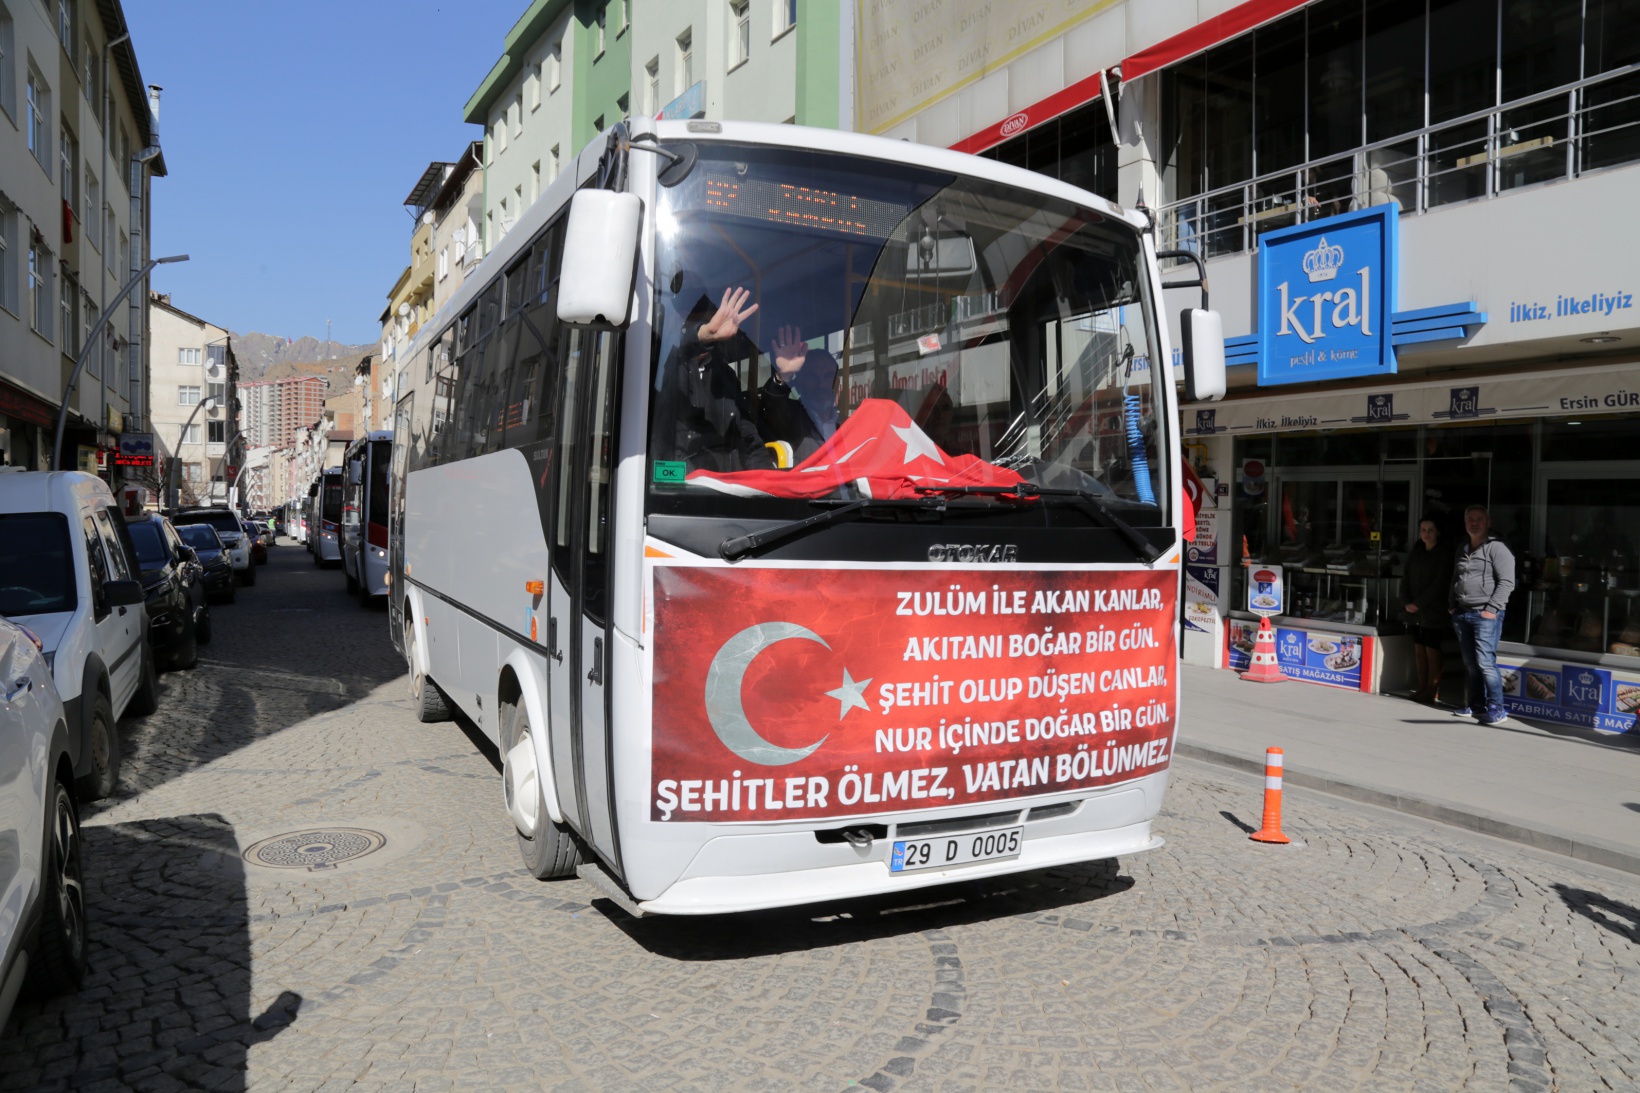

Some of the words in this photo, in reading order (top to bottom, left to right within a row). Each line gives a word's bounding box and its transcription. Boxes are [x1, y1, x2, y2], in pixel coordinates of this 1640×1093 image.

[1276, 266, 1373, 344] kral
[1510, 302, 1552, 323] İlkiz,
[1556, 291, 1633, 317] İlkeliyiz
[1317, 351, 1327, 361] &
[1369, 403, 1391, 418] kral
[1452, 397, 1477, 413] kral
[1560, 396, 1598, 409] Ersin
[928, 543, 1018, 563] OTOKAR
[896, 585, 987, 616] ZULÜM
[992, 584, 1027, 614] İLE
[1031, 589, 1091, 615] AKAN
[1094, 587, 1165, 613] KANLAR,
[903, 634, 1003, 662] AKITANI
[1008, 626, 1082, 658] BOĞAR
[1086, 624, 1116, 653] BİR
[1119, 623, 1160, 650] GÜN.
[1279, 640, 1302, 659] kral
[1302, 669, 1345, 682] MAĞAZASI
[878, 675, 954, 715] ŞEHİT
[959, 676, 1023, 703] OLUP
[1027, 667, 1096, 704] DÜŞEN
[1099, 663, 1168, 693] CANLAR,
[1568, 680, 1603, 705] kral
[1511, 702, 1560, 718] FABRİKA
[1565, 712, 1600, 728] SATIŞ
[874, 727, 932, 754] NUR
[938, 718, 1021, 757] İÇİNDE
[1025, 708, 1097, 741] DOĞAR
[1101, 706, 1133, 732] BİR
[1136, 701, 1170, 728] GÜN.
[656, 770, 830, 821] ŞEHİTLER
[837, 764, 955, 804] ÖLMEZ,
[963, 758, 1051, 795] VATAN
[1055, 737, 1170, 784] BÖLÜNMEZ.
[905, 843, 931, 866] 29
[945, 839, 958, 862] D
[972, 831, 1019, 858] 0005
